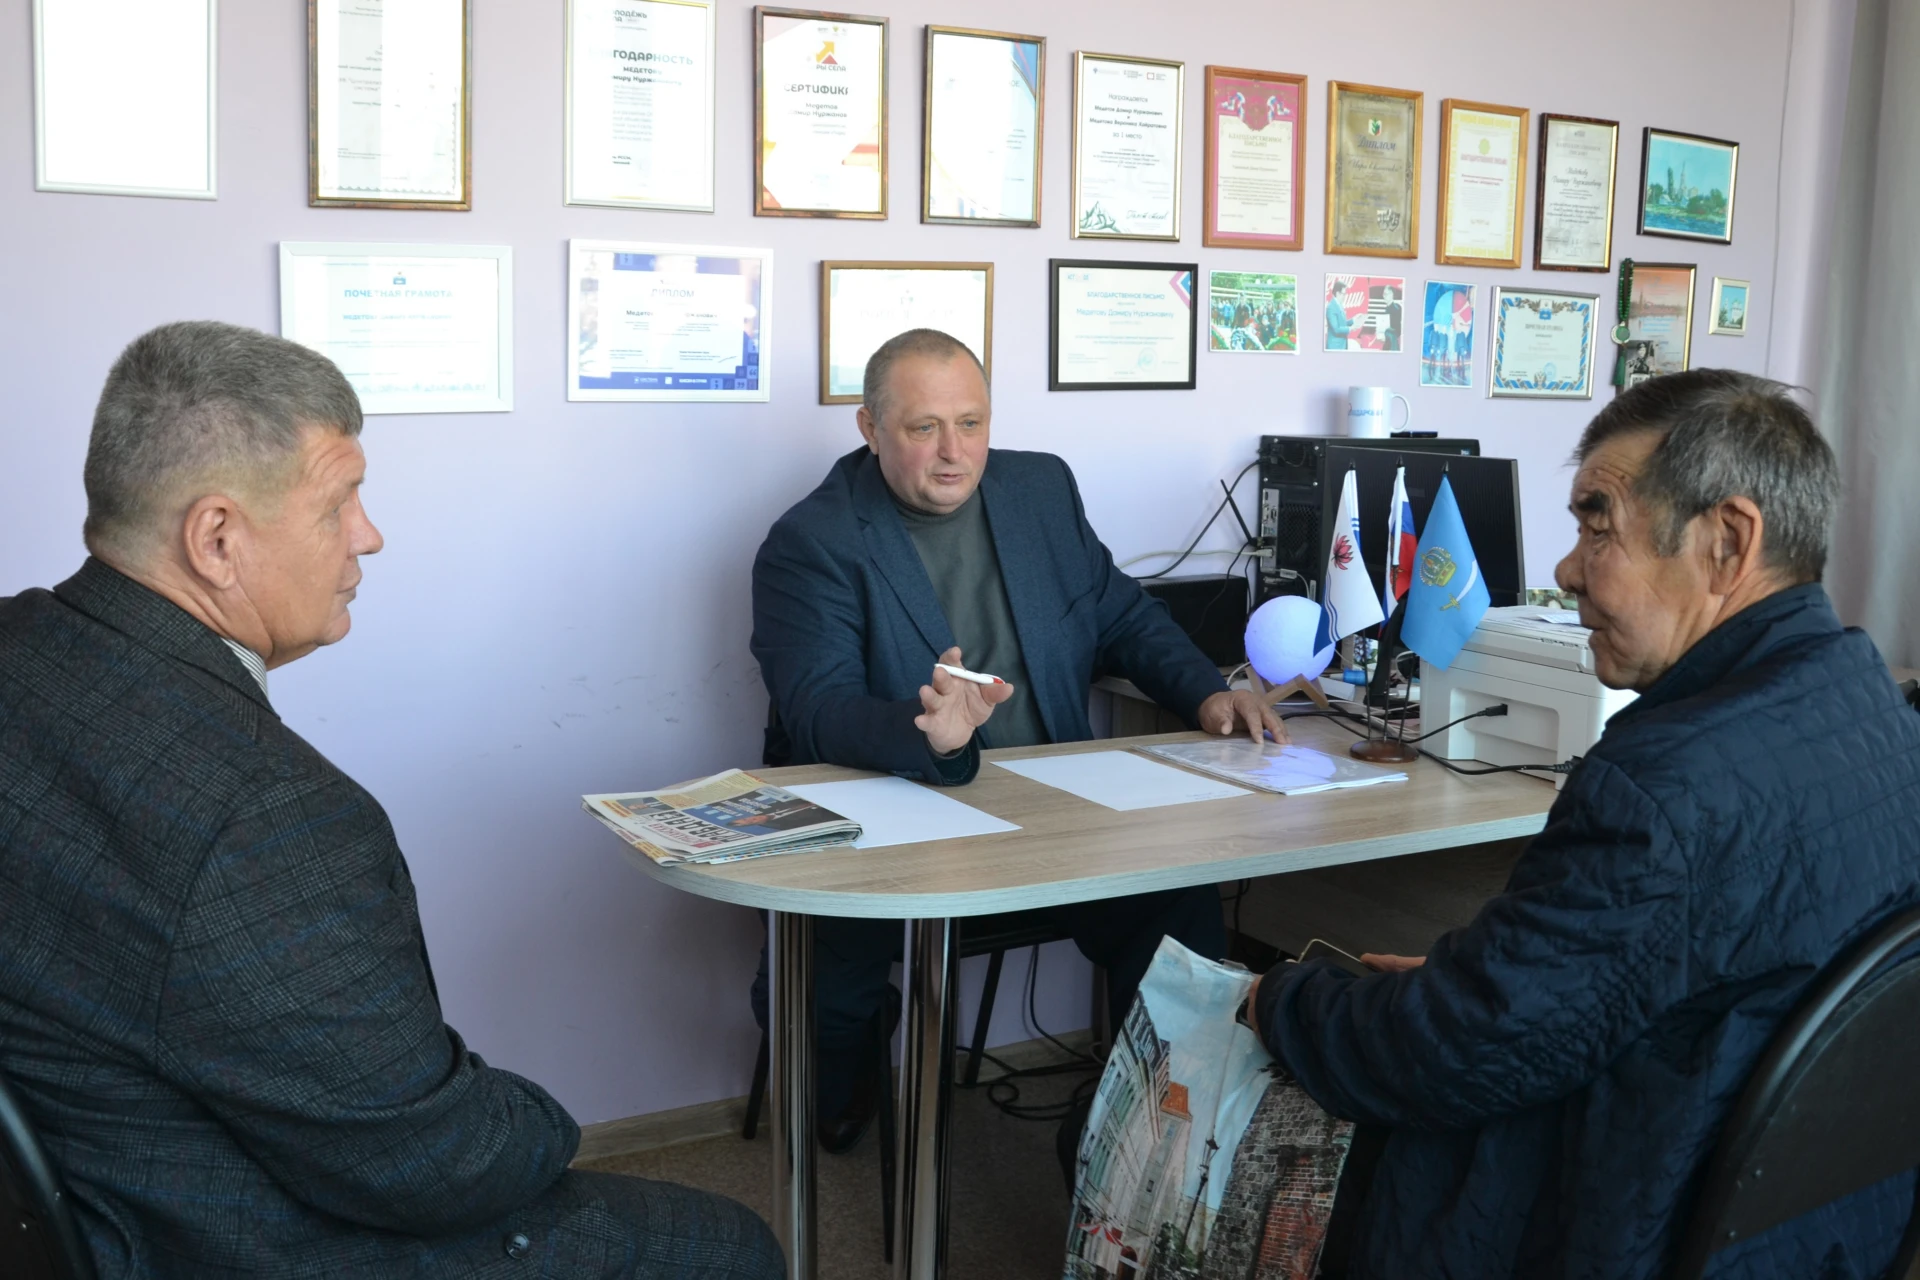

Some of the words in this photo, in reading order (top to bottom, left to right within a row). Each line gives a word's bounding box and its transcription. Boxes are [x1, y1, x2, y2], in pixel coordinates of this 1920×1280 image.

[613, 10, 647, 19] ЛОДЁЖЬ
[612, 50, 693, 65] ГОДАРНОСТЬ
[1108, 94, 1148, 103] Награждается
